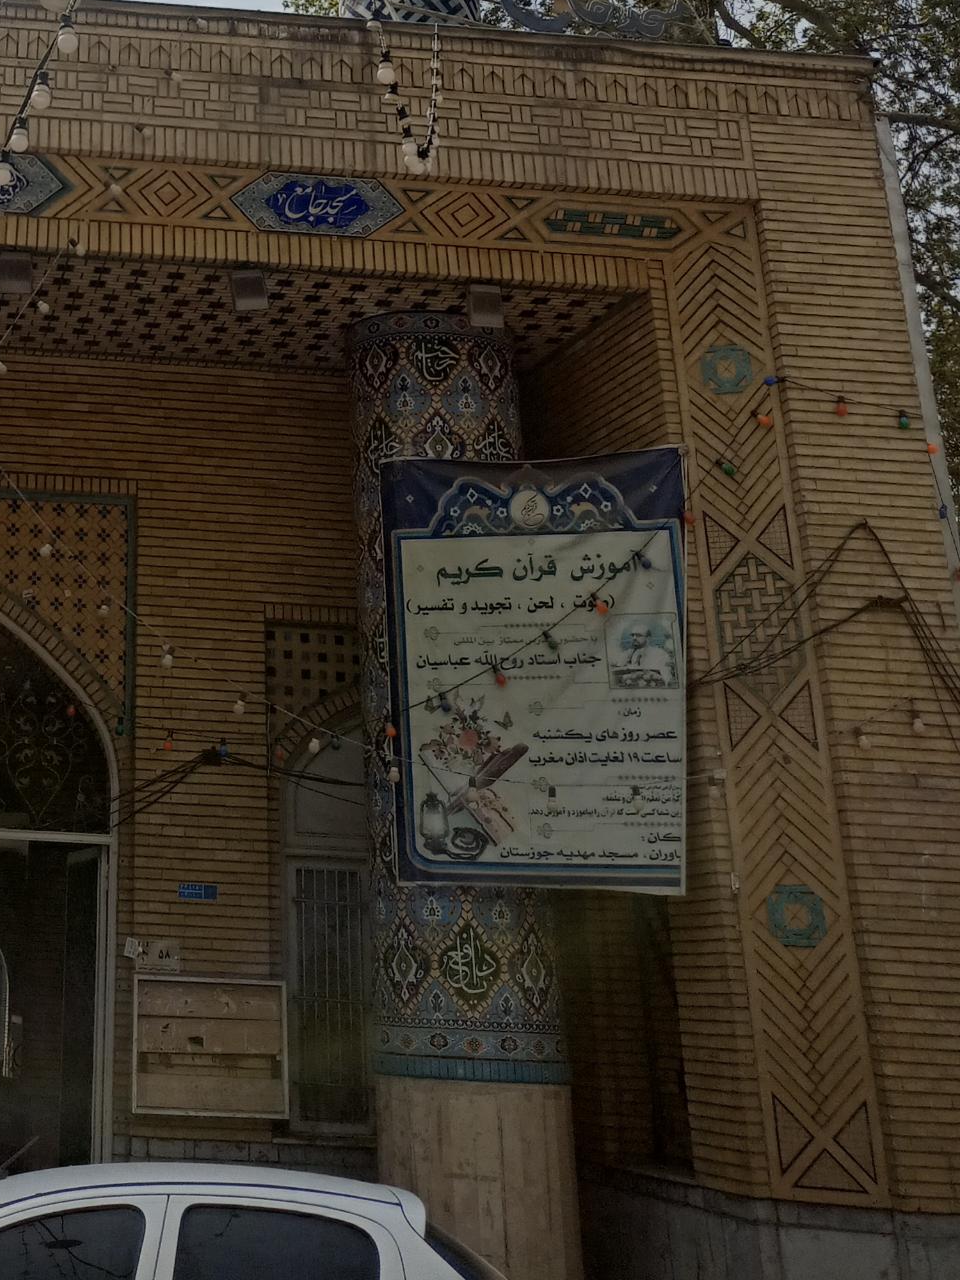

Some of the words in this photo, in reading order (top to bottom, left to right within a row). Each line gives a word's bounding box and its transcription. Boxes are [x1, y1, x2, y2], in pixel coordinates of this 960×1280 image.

[284, 185, 330, 221] جامع
[320, 188, 357, 223] مسجد
[436, 558, 504, 587] کریم
[512, 553, 557, 581] قرآن
[570, 551, 639, 581] آموزش
[406, 596, 455, 616] تفسیر)
[460, 602, 468, 615] و
[470, 596, 512, 614] تجوید
[527, 594, 554, 613] لحن
[477, 635, 496, 646] بین
[499, 634, 525, 646] ممتاز
[416, 653, 470, 670] عباسیان
[474, 649, 498, 667] الله
[500, 656, 524, 671] روح
[527, 652, 561, 666] استاد
[564, 652, 601, 669] جناب
[623, 706, 642, 718] زمان
[532, 728, 593, 744] یکشنبه
[642, 728, 678, 743] عصر
[528, 753, 564, 767] مغرب
[564, 751, 588, 766] اذان
[589, 751, 625, 767] لغایت
[628, 752, 640, 763] ۱۹
[641, 751, 682, 763] ساعت
[648, 831, 682, 845] کان
[499, 847, 555, 861] جوزستان
[556, 849, 596, 862] مهدیه
[598, 849, 639, 862] مسجد
